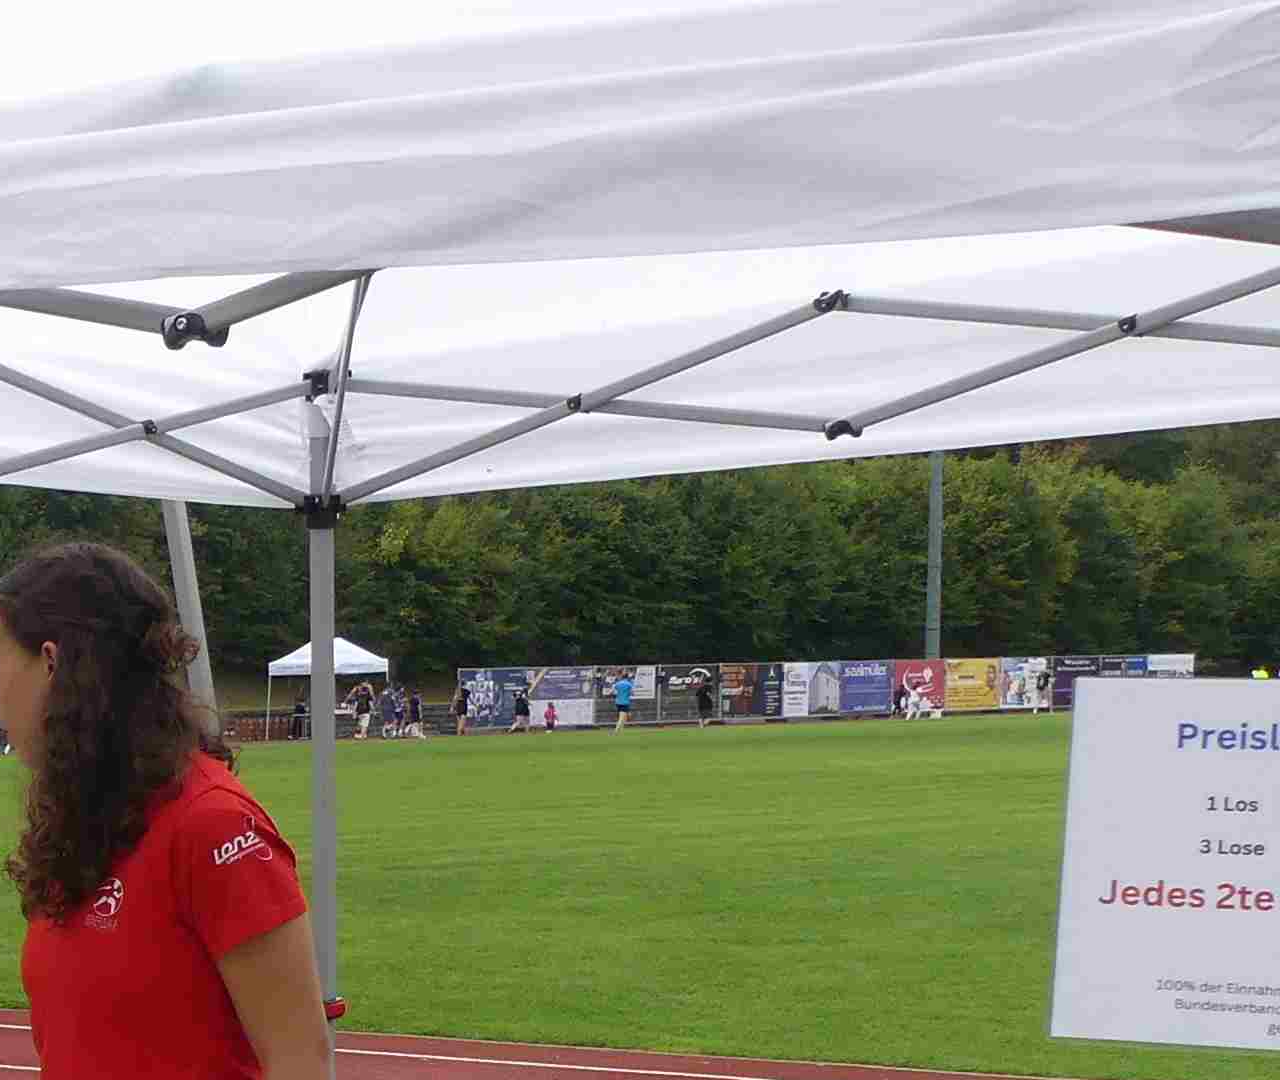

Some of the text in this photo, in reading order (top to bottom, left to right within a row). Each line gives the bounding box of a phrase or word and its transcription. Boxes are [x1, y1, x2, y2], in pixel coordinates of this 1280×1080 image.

[1177, 722, 1280, 751] Preisl
[1207, 796, 1259, 813] 1 Los
[1199, 839, 1265, 856] 3 Lose
[1098, 879, 1274, 911] Jedes 2te
[1199, 981, 1223, 994] der
